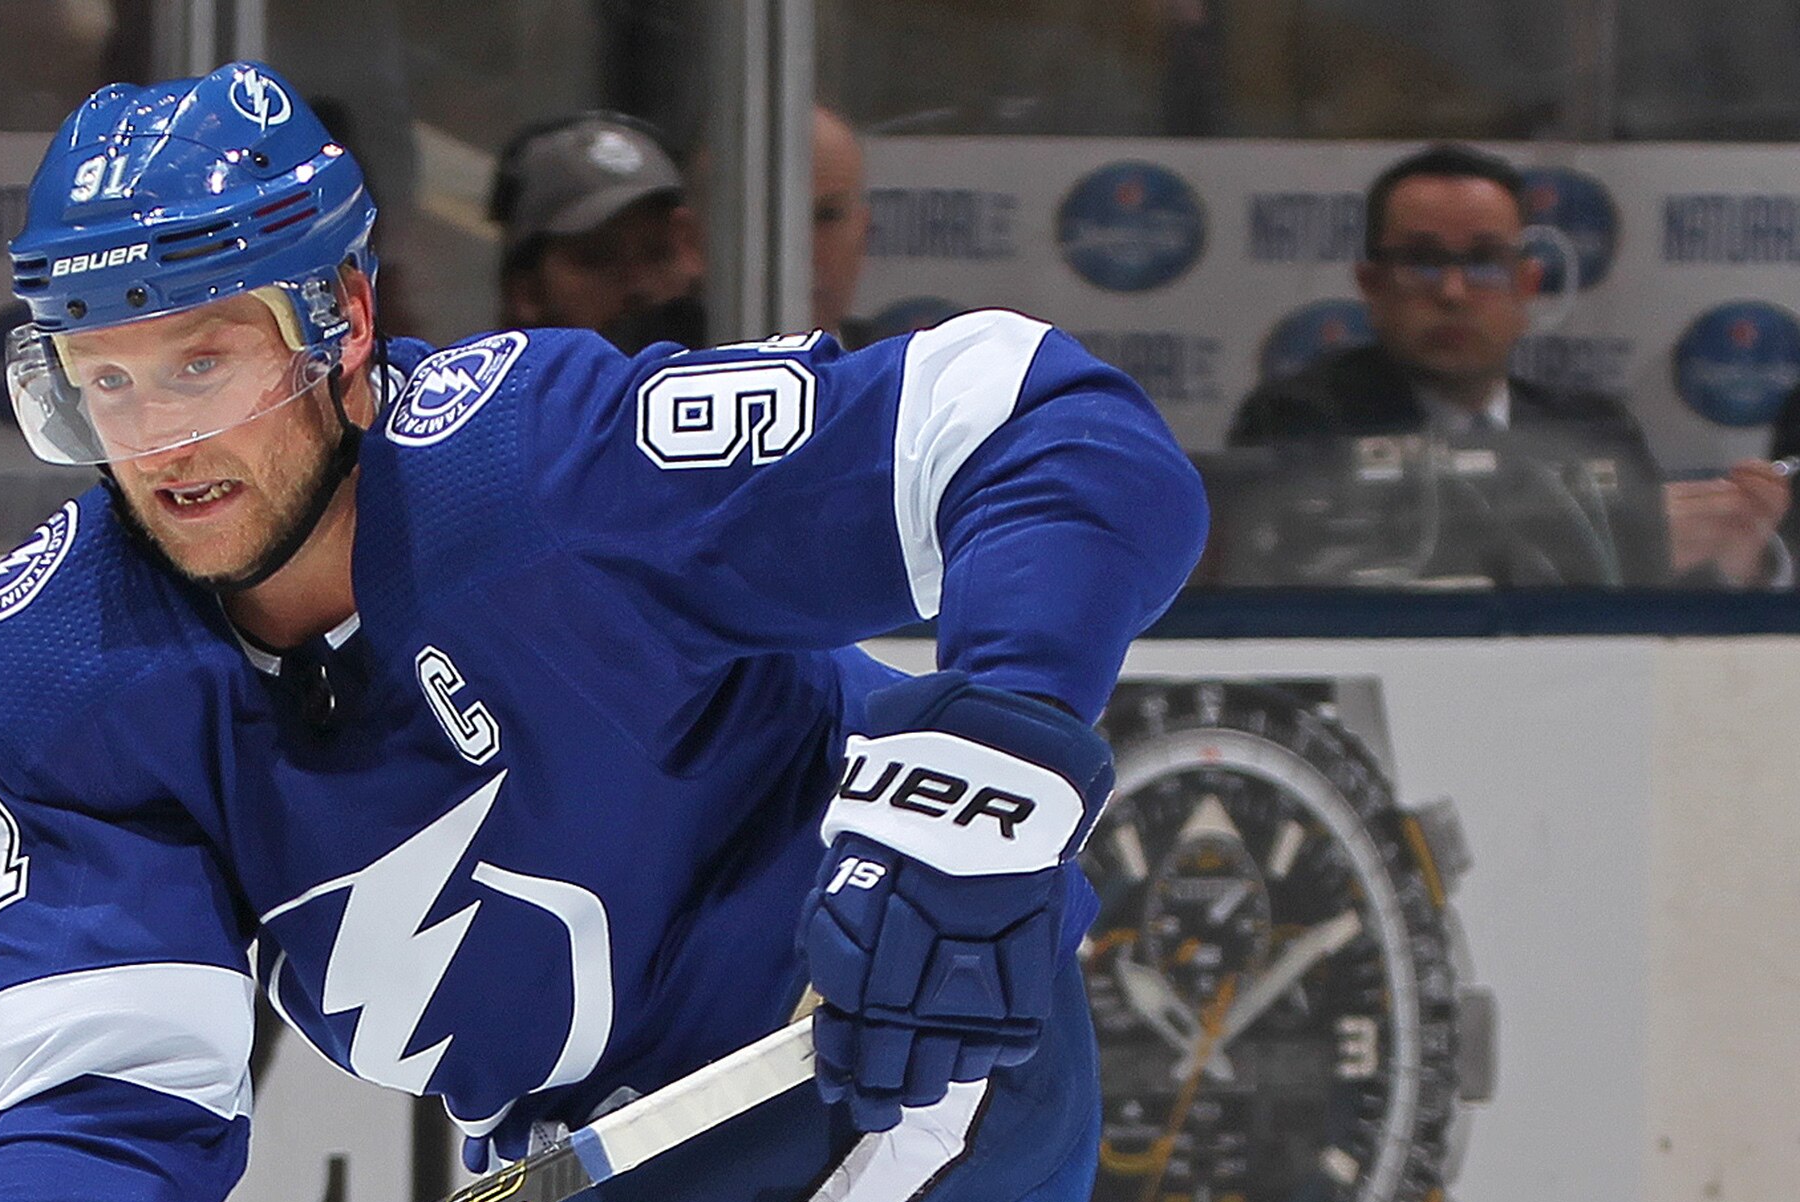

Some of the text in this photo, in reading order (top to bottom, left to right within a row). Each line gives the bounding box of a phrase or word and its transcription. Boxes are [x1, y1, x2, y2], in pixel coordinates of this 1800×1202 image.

[67, 155, 131, 202] 91
[51, 242, 150, 277] BAUER
[415, 645, 501, 765] C
[840, 755, 1036, 840] UER
[1335, 1016, 1378, 1078] 3
